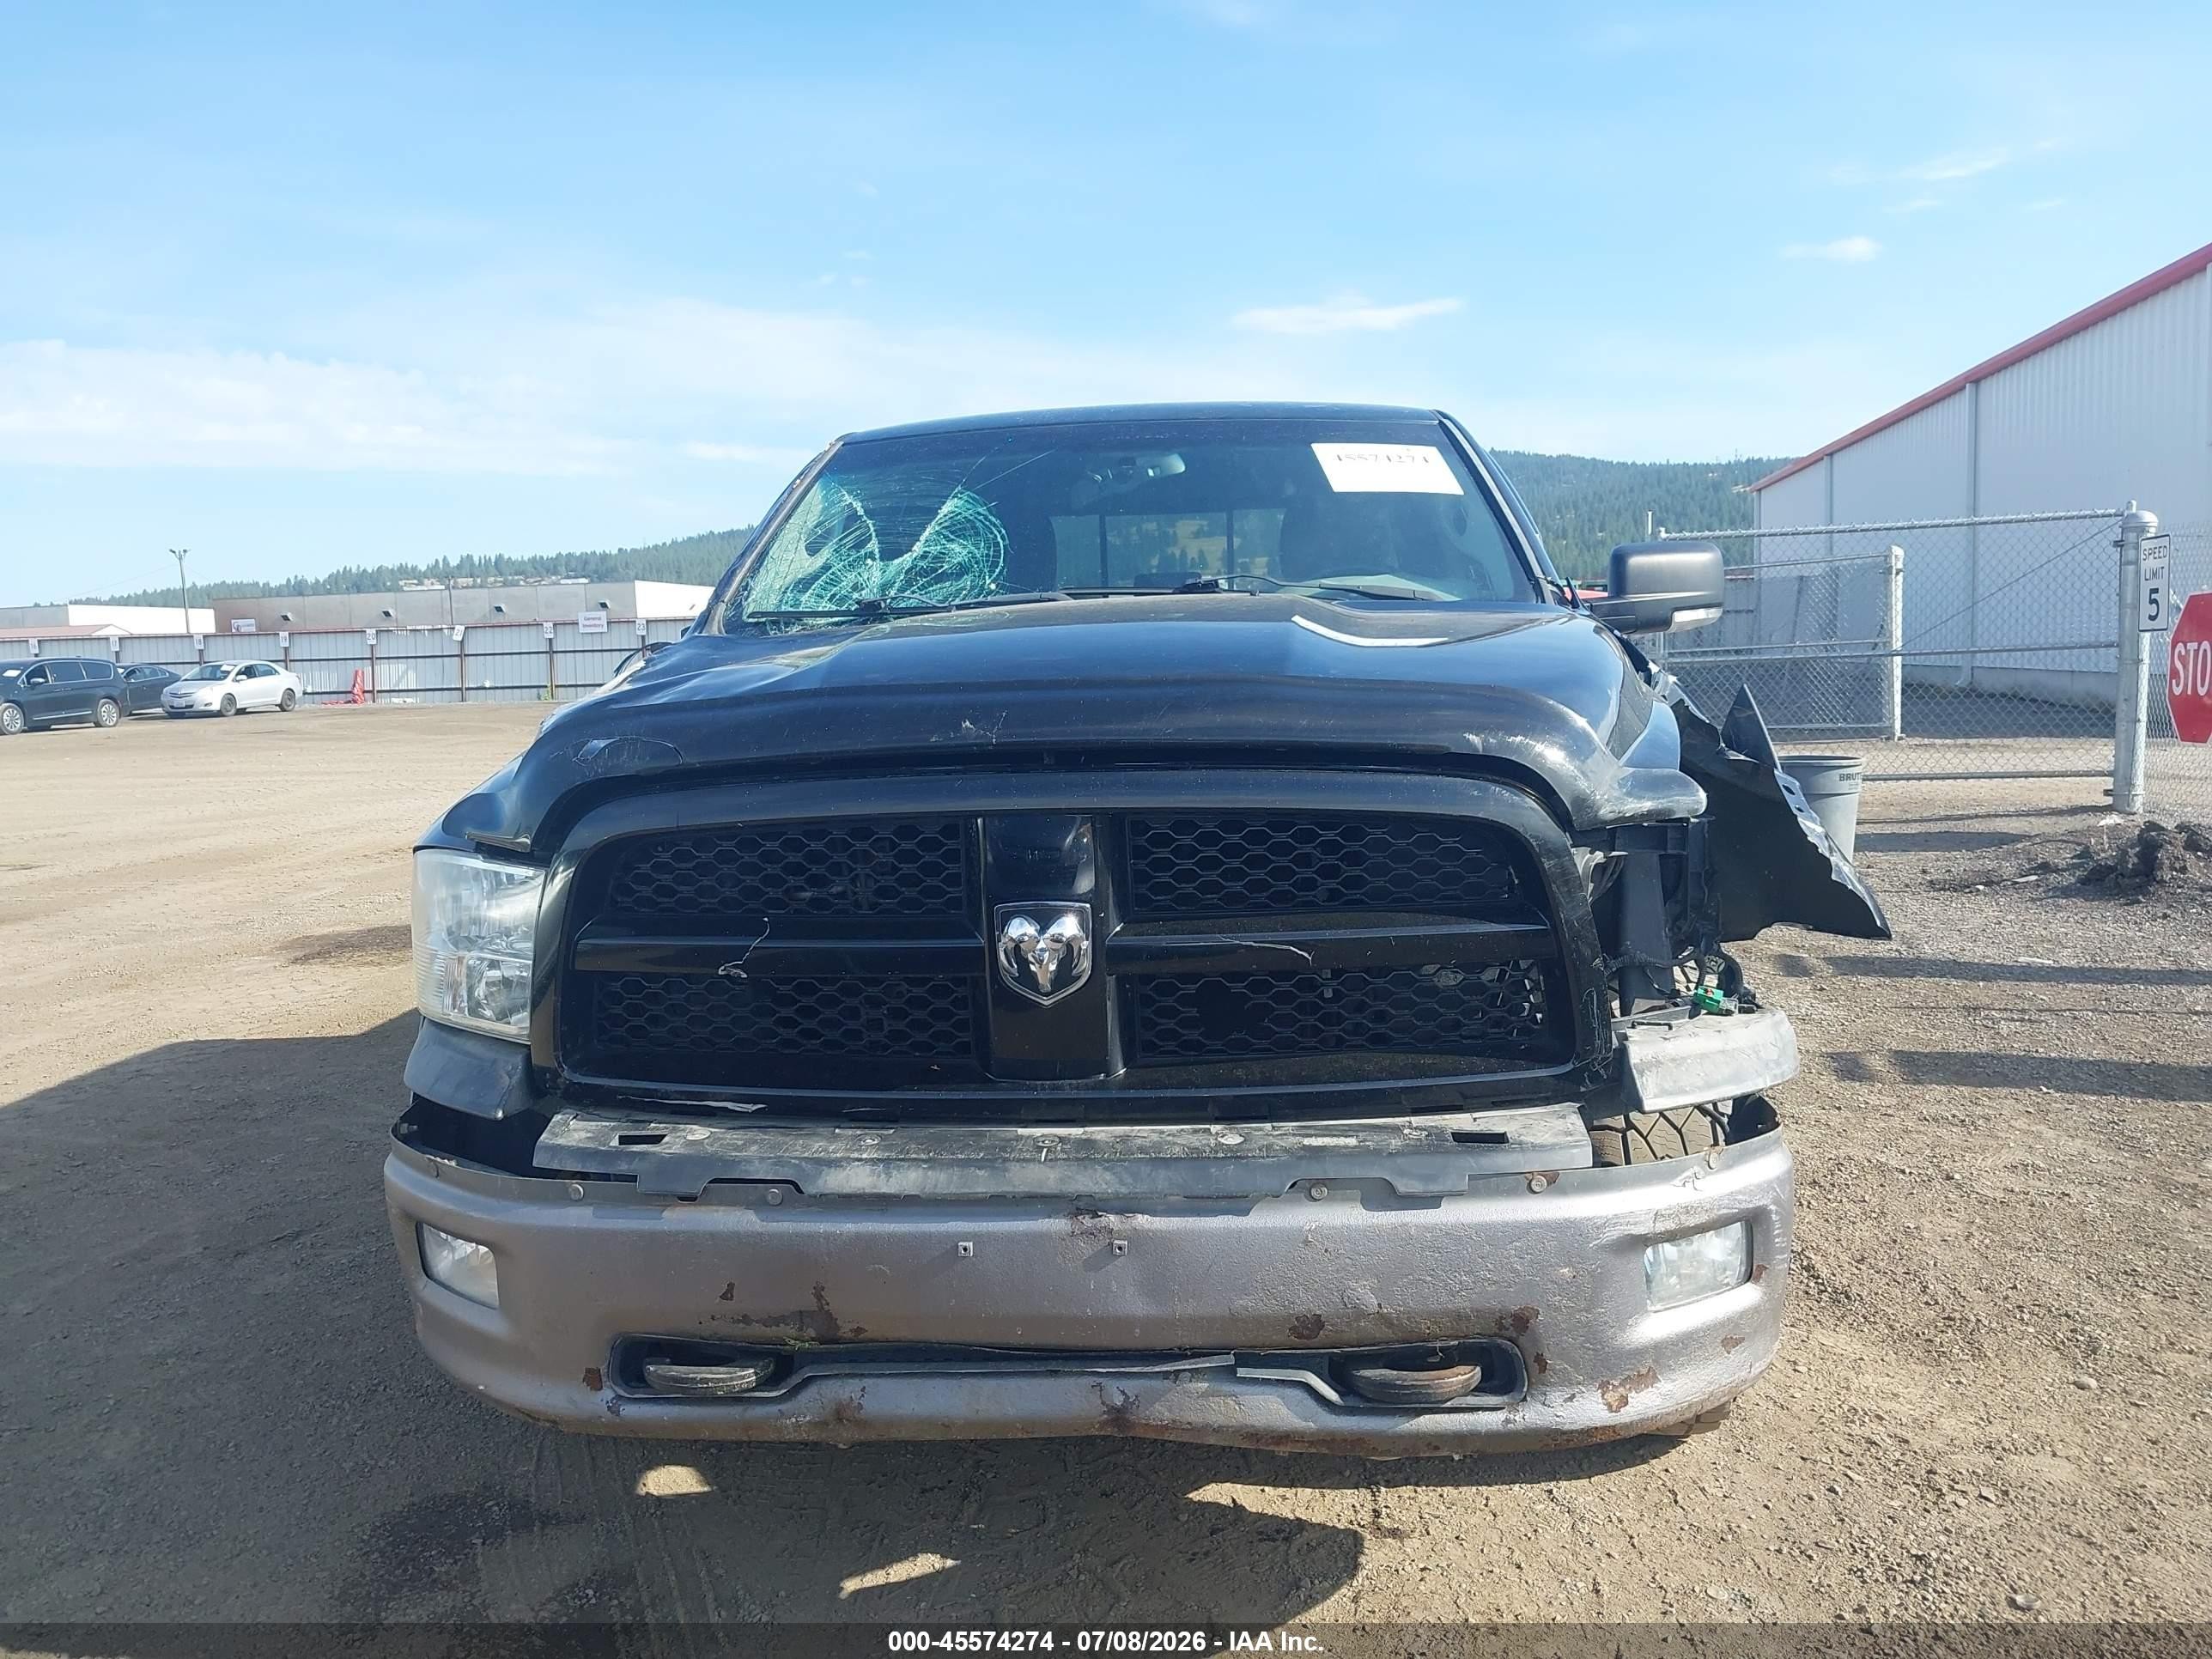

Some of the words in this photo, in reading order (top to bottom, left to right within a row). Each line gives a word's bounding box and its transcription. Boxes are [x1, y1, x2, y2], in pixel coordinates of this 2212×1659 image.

[2142, 545, 2168, 562] SPEED
[2144, 567, 2165, 581] LIMIT
[2148, 587, 2160, 622] 5
[637, 623, 646, 631] 23
[2172, 641, 2211, 696] STO
[1838, 773, 1862, 781] BRUT
